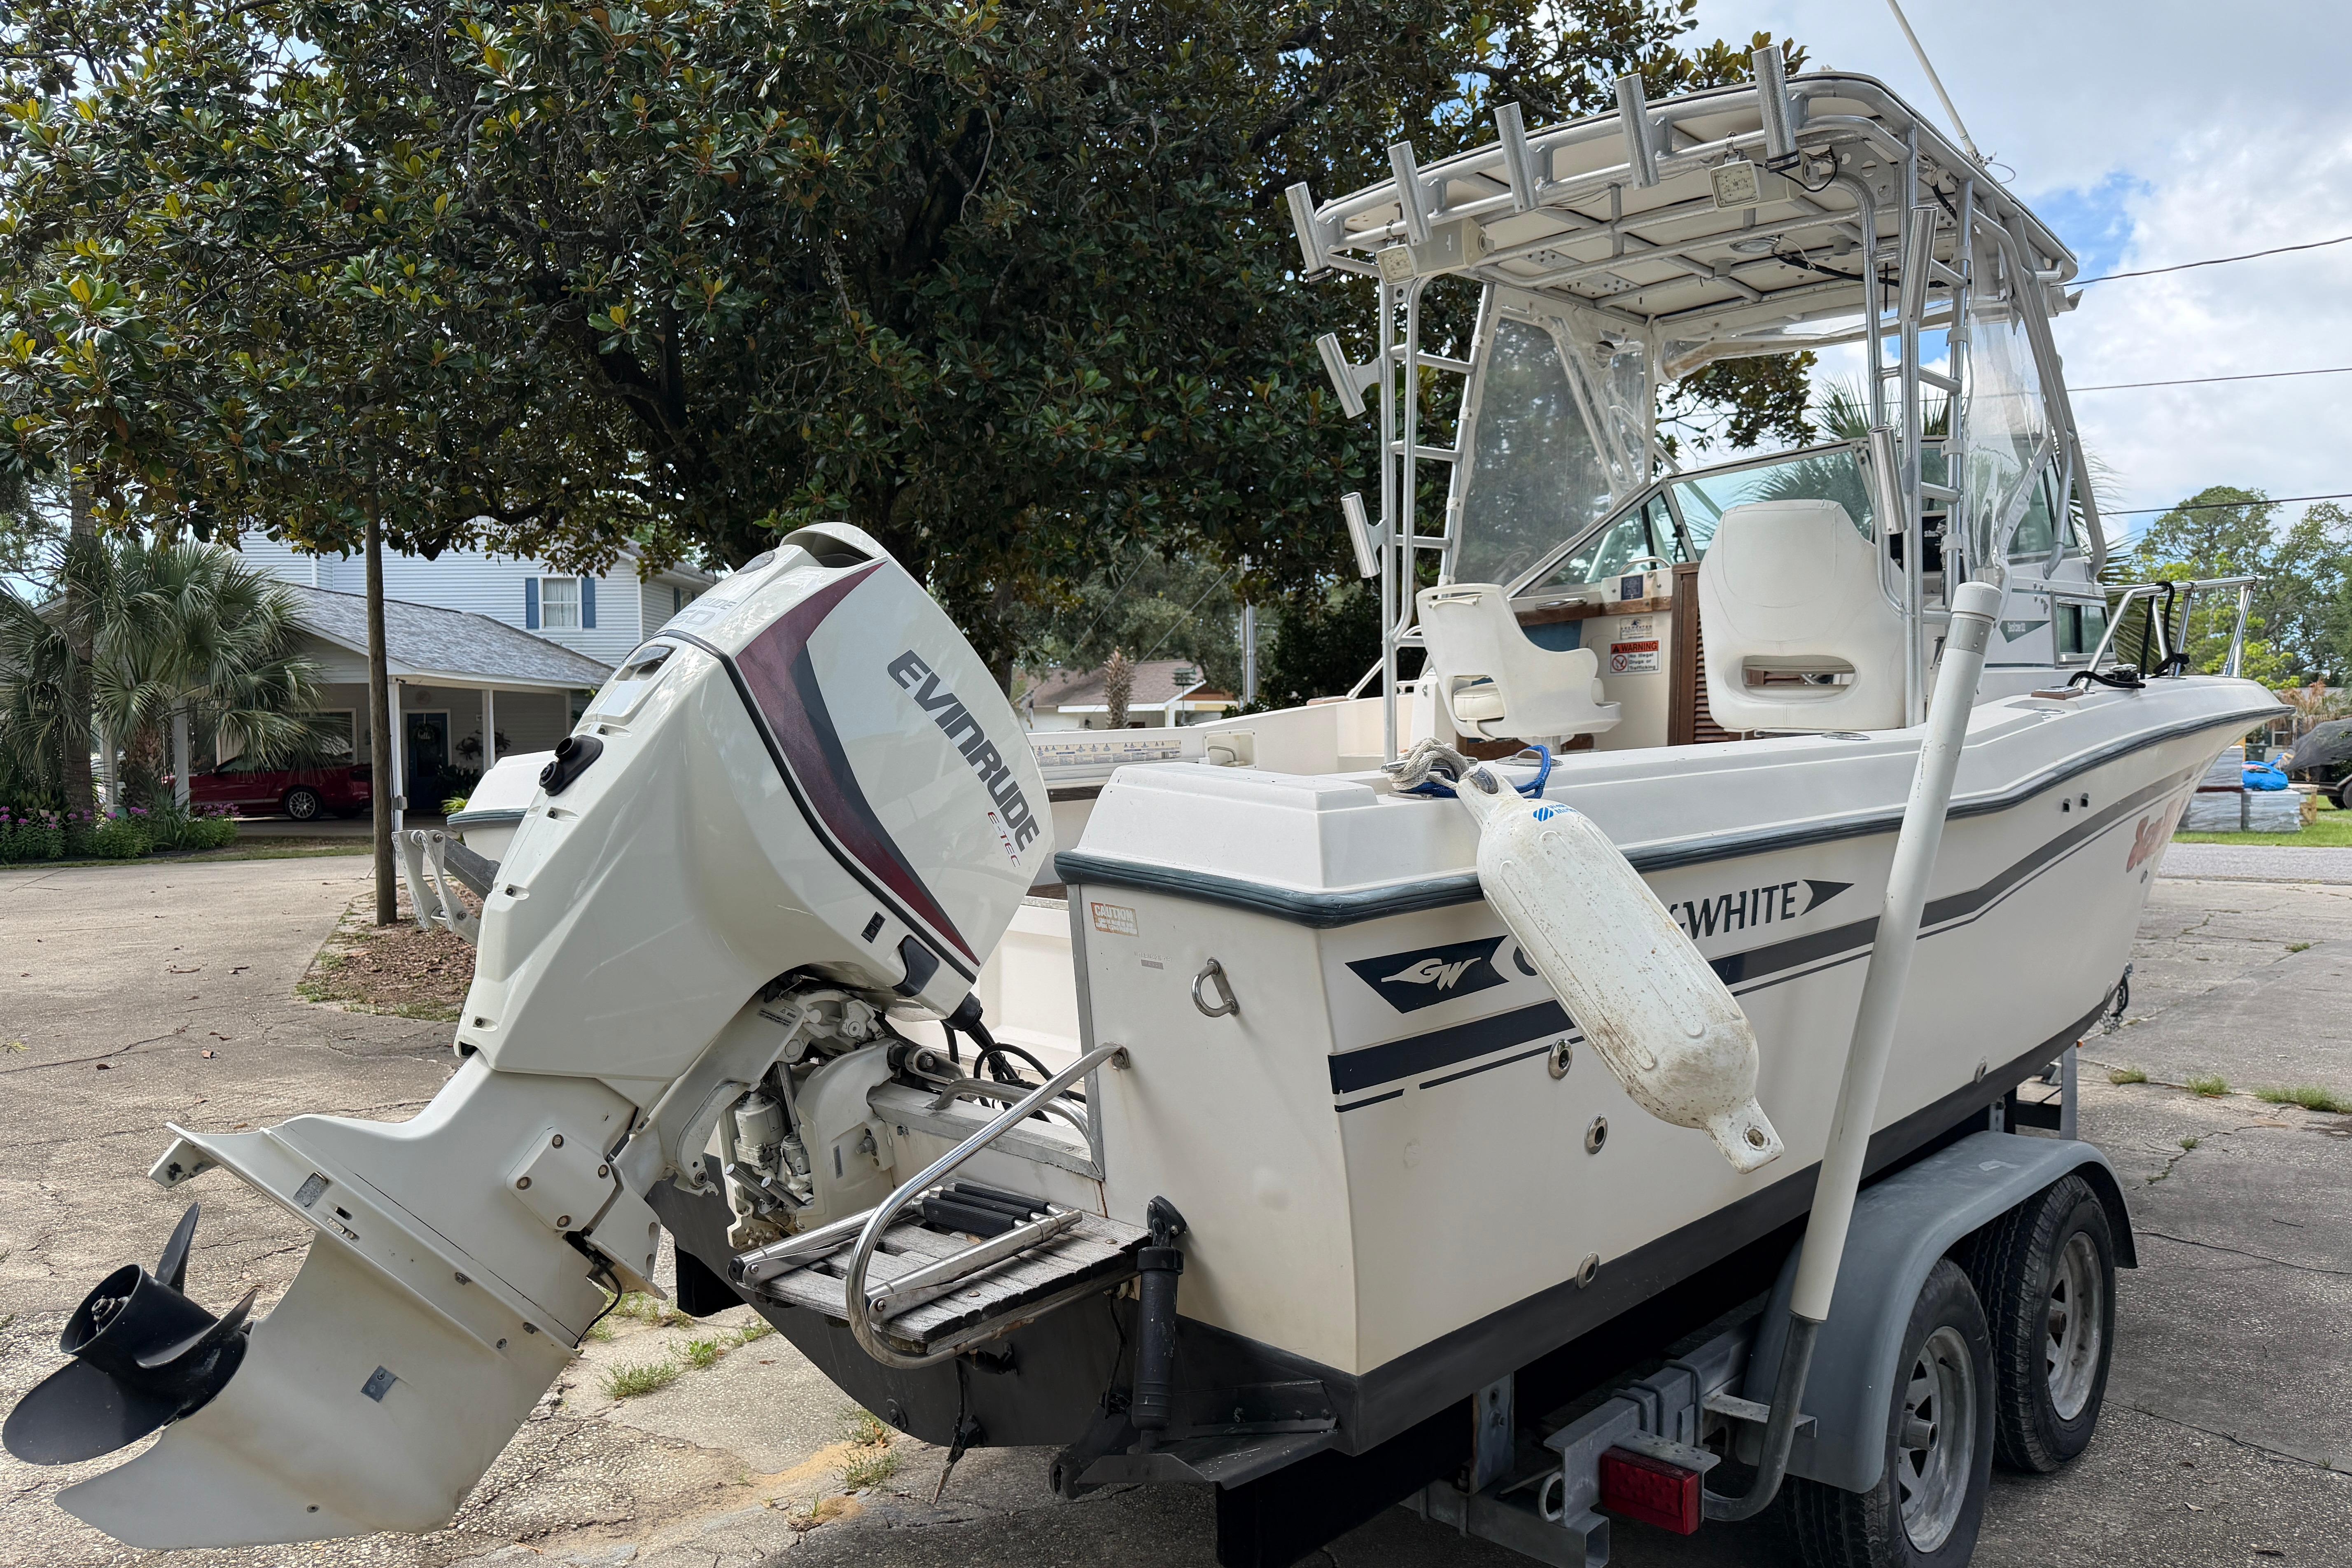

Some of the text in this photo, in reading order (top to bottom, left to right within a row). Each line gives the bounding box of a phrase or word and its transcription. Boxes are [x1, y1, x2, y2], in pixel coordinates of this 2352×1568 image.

[1622, 642, 1657, 651] WARNING
[887, 649, 1040, 852] EVINRUDE
[988, 812, 1021, 868] E-TEC
[1094, 905, 1134, 921] CAUTION
[1669, 881, 1797, 939] WHITE
[1381, 958, 1481, 991] GW
